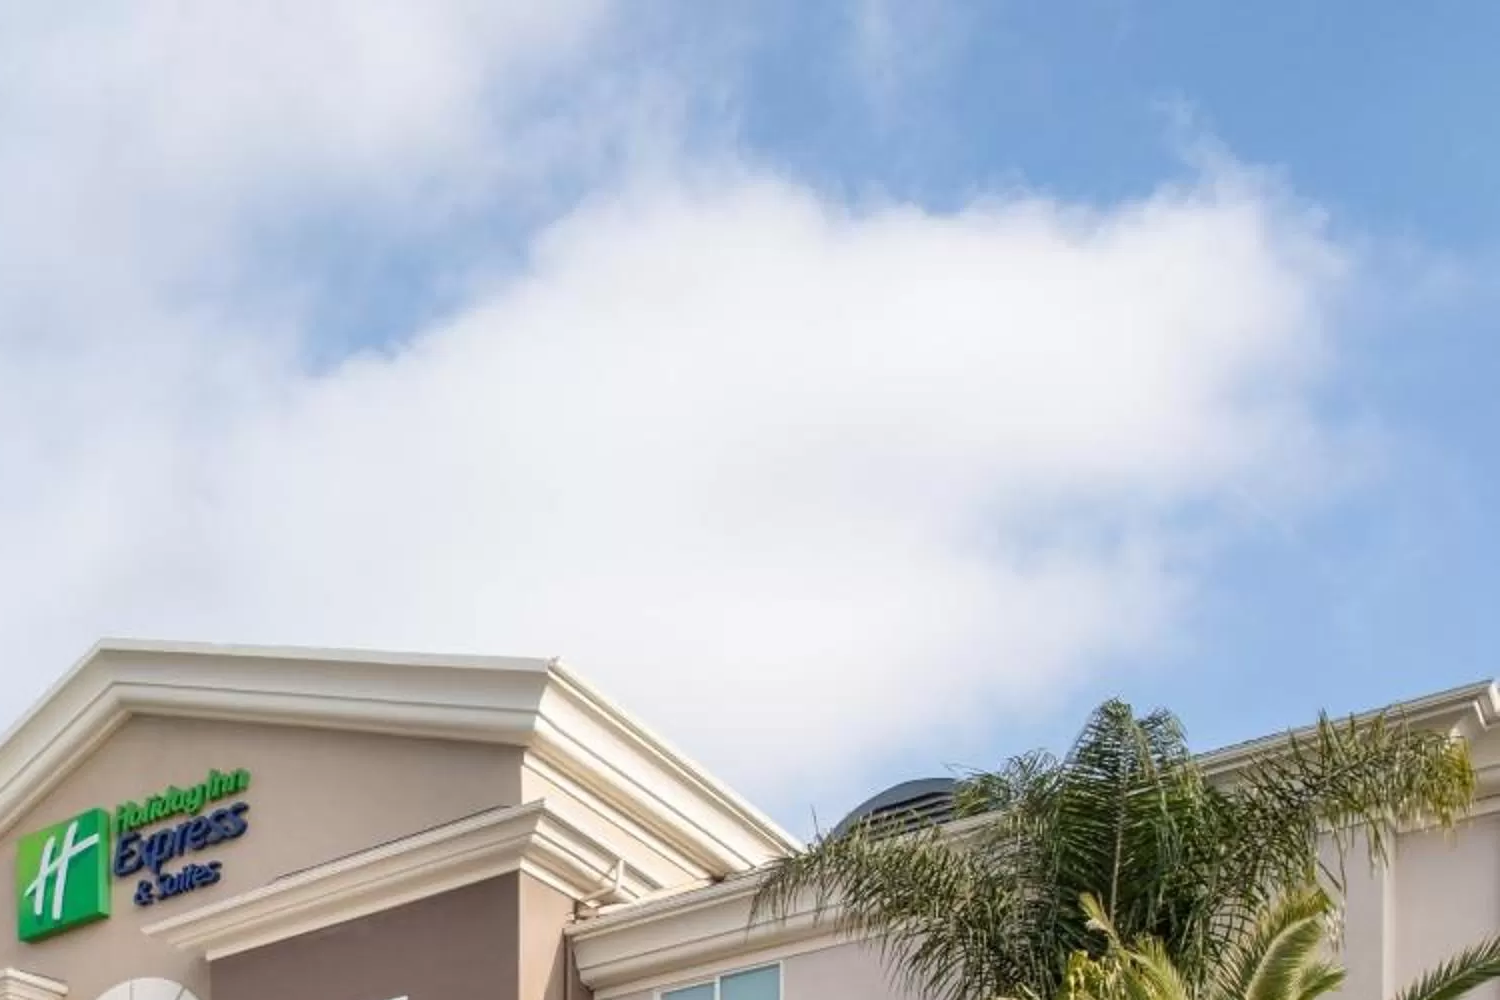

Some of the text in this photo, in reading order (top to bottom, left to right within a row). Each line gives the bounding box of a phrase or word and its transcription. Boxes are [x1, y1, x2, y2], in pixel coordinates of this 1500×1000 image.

[113, 768, 250, 832] Holiday Inn
[114, 802, 249, 876] Express
[134, 860, 222, 905] & Suites
